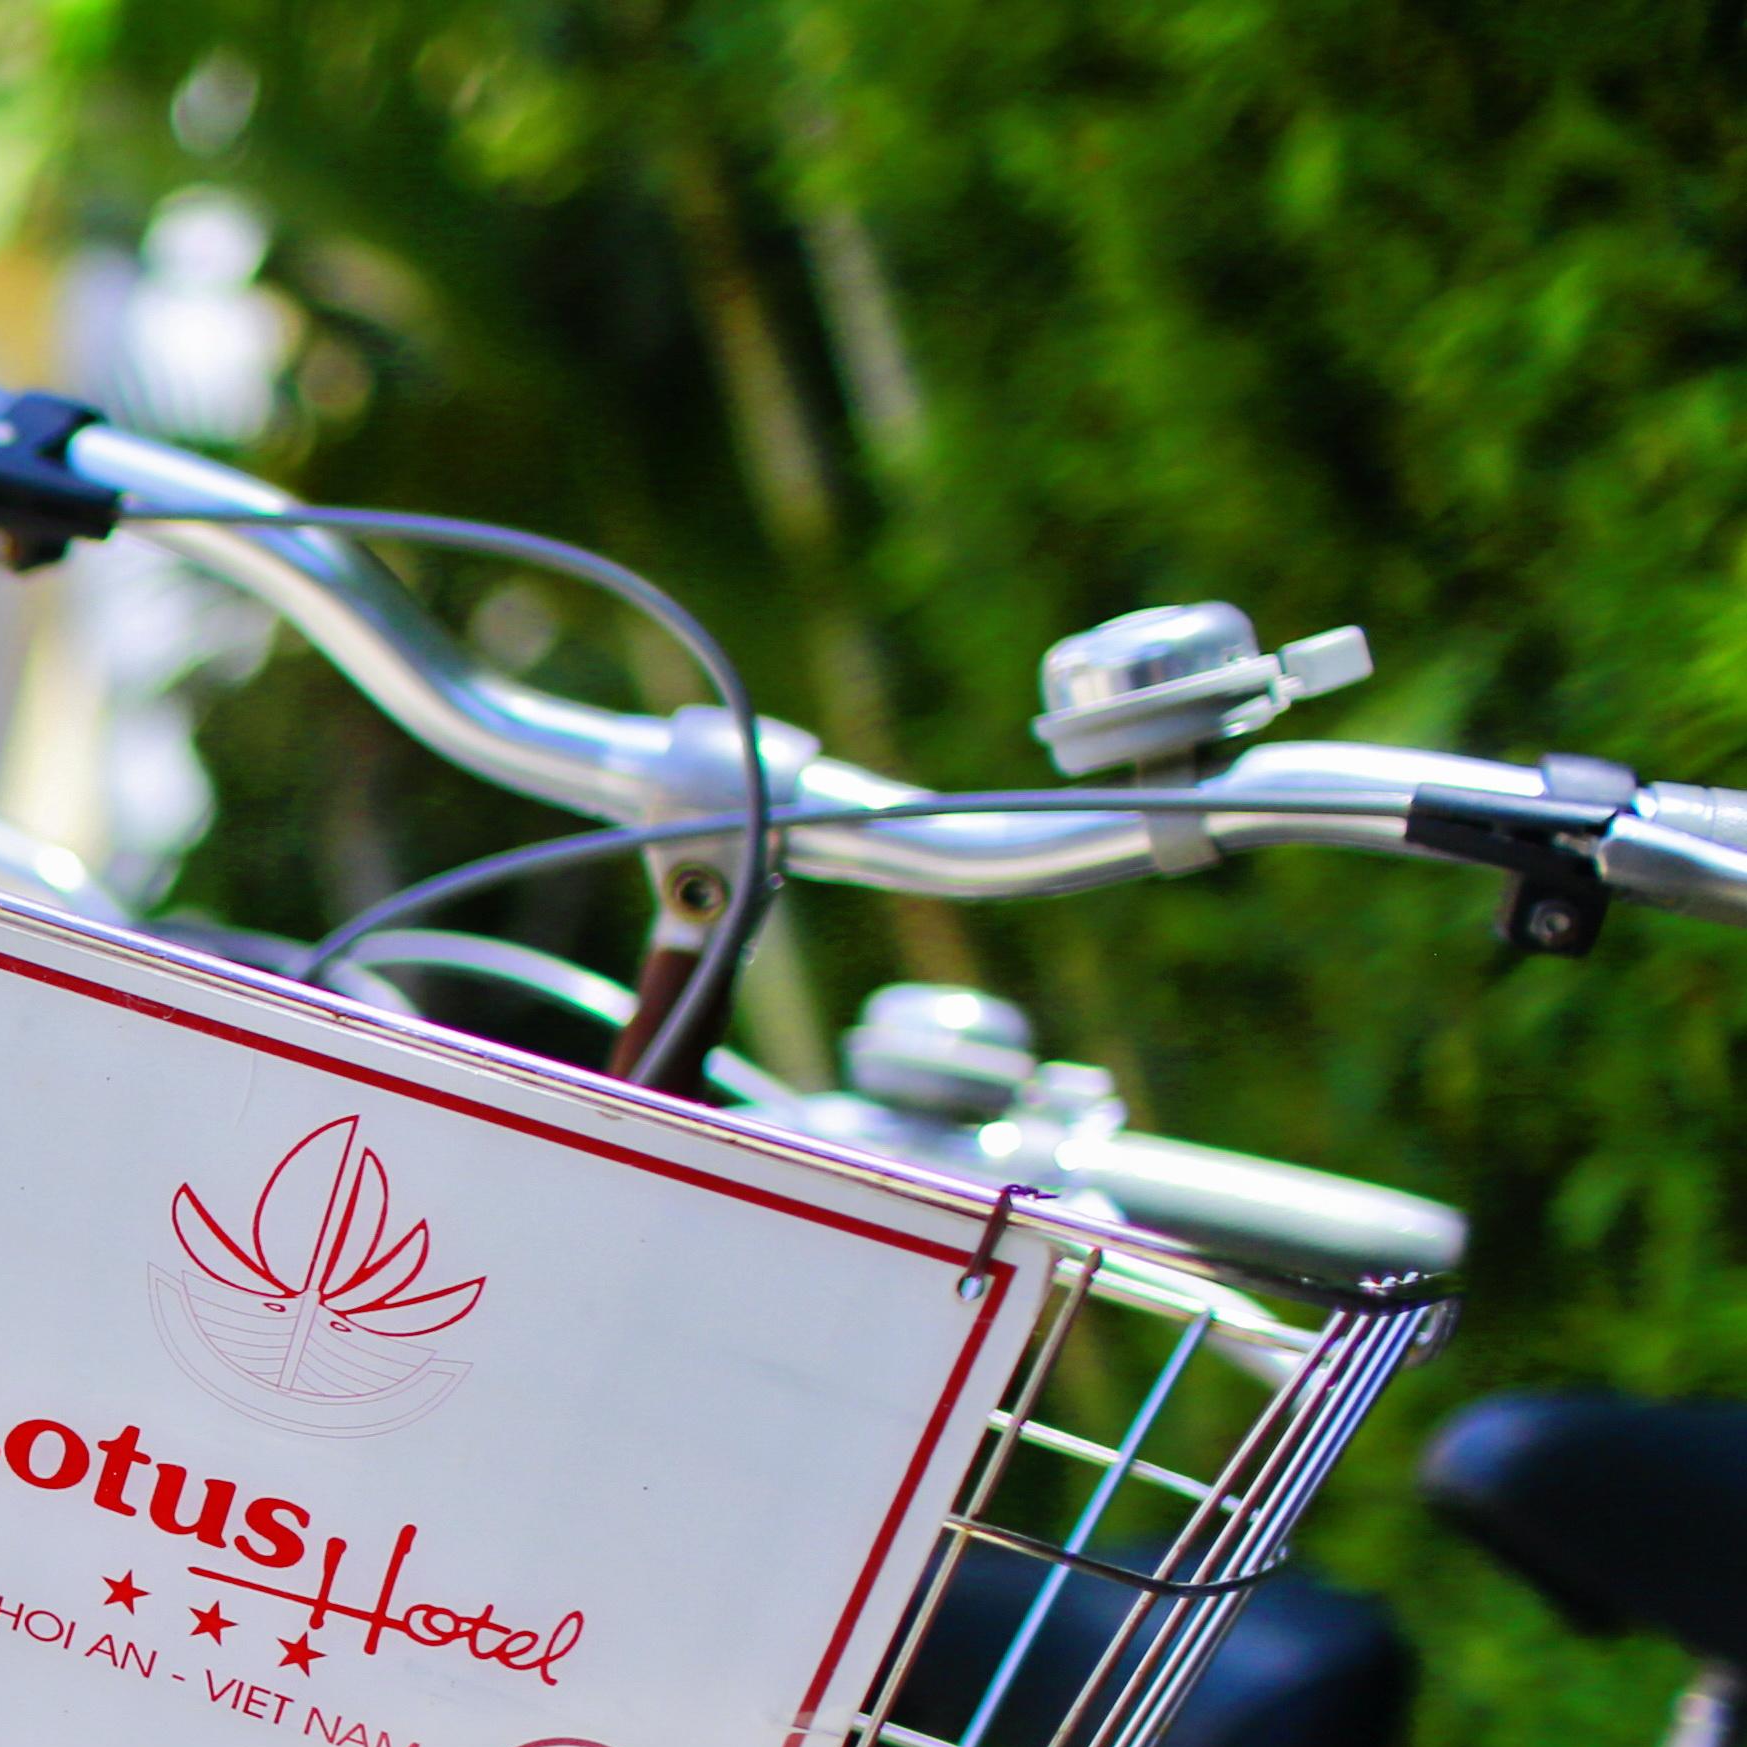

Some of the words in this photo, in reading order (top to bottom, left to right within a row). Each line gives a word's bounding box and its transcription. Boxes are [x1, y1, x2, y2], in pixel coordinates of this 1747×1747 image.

[187, 1523, 585, 1687] Hotel
[84, 1632, 158, 1679] AN
[204, 1667, 294, 1726] VIET
